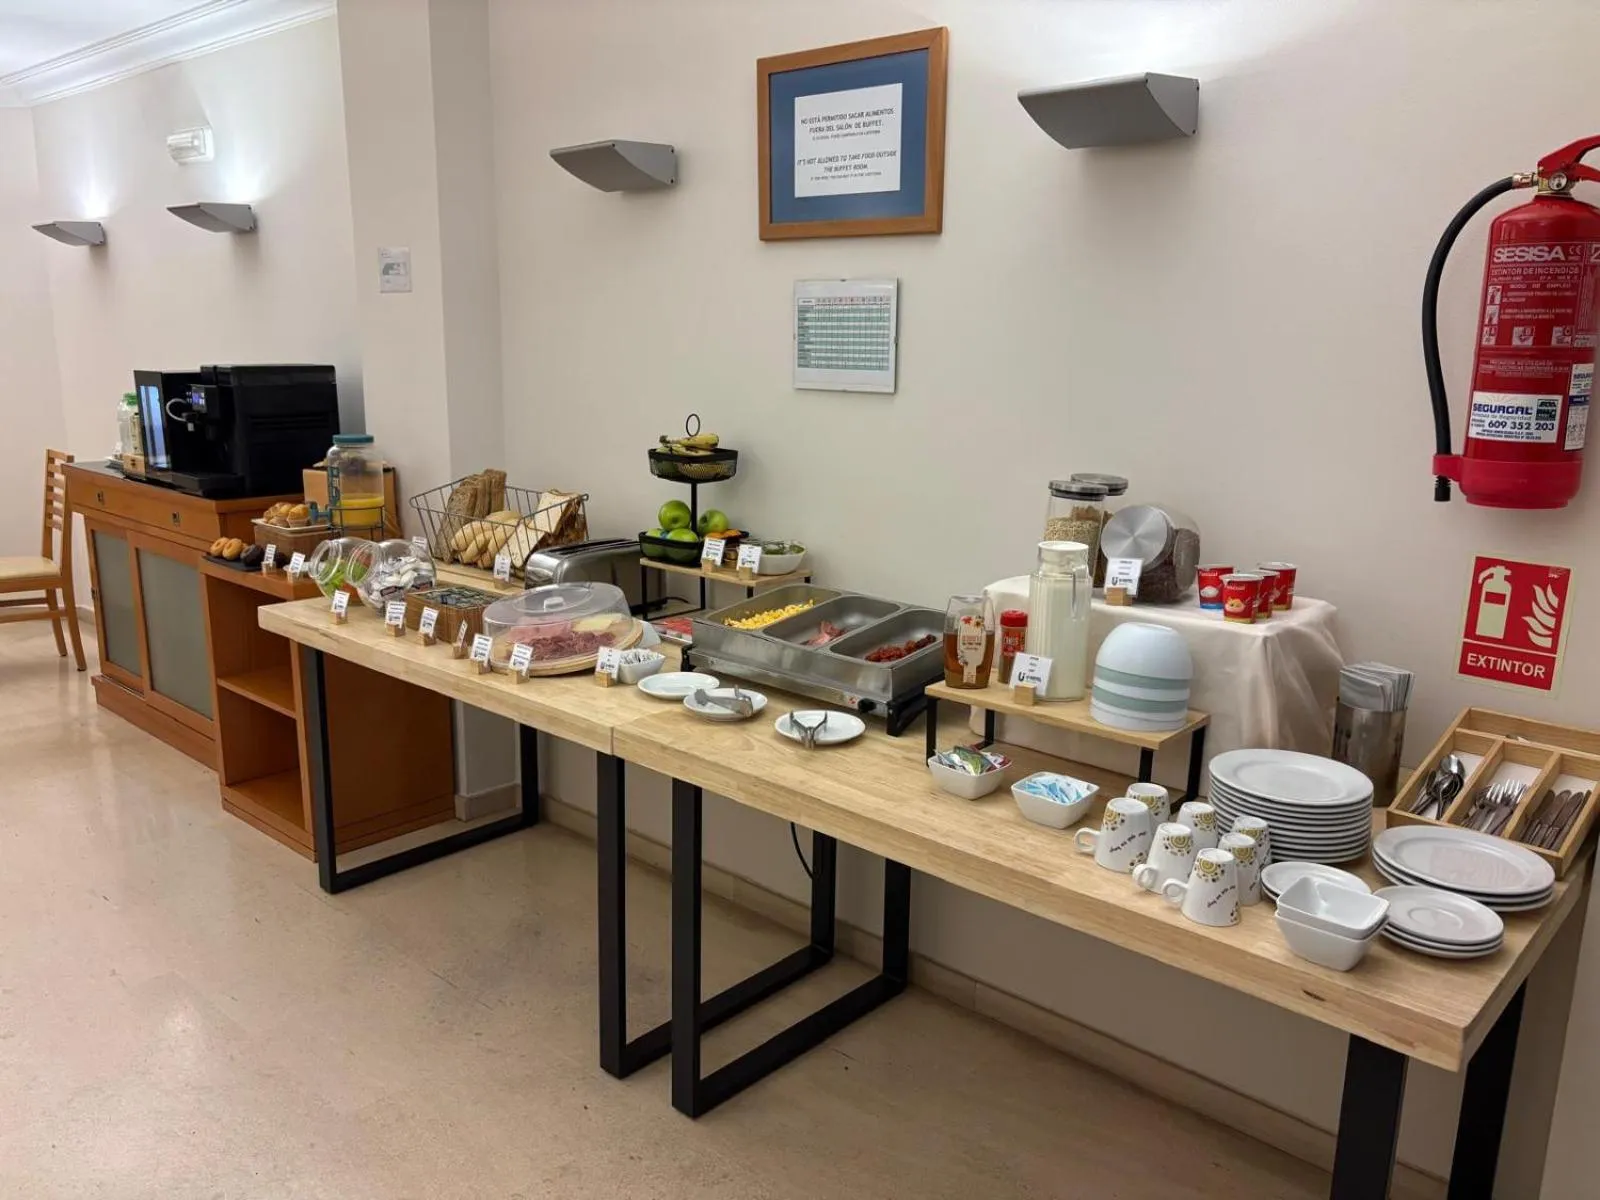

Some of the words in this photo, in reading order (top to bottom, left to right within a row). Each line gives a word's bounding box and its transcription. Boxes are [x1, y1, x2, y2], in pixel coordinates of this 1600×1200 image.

[822, 114, 848, 122] PERMITIDO
[865, 108, 894, 118] ALIMENTOS
[809, 126, 825, 134] FUERA
[826, 124, 835, 132] DEL
[836, 122, 852, 131] SALÓN
[807, 157, 816, 165] NOT
[816, 156, 840, 164] ALLOWED
[876, 150, 897, 158] OUTSIDE
[833, 164, 852, 172] BUFFET
[1494, 246, 1566, 262] SESISA
[1523, 267, 1534, 275] DE
[1535, 266, 1580, 275] INCENDIOS
[1473, 403, 1533, 415] SEGURGAL
[1488, 420, 1508, 429] 609
[1510, 421, 1531, 431] 352
[1534, 422, 1555, 431] 203
[1466, 653, 1546, 678] EXTINTOR
